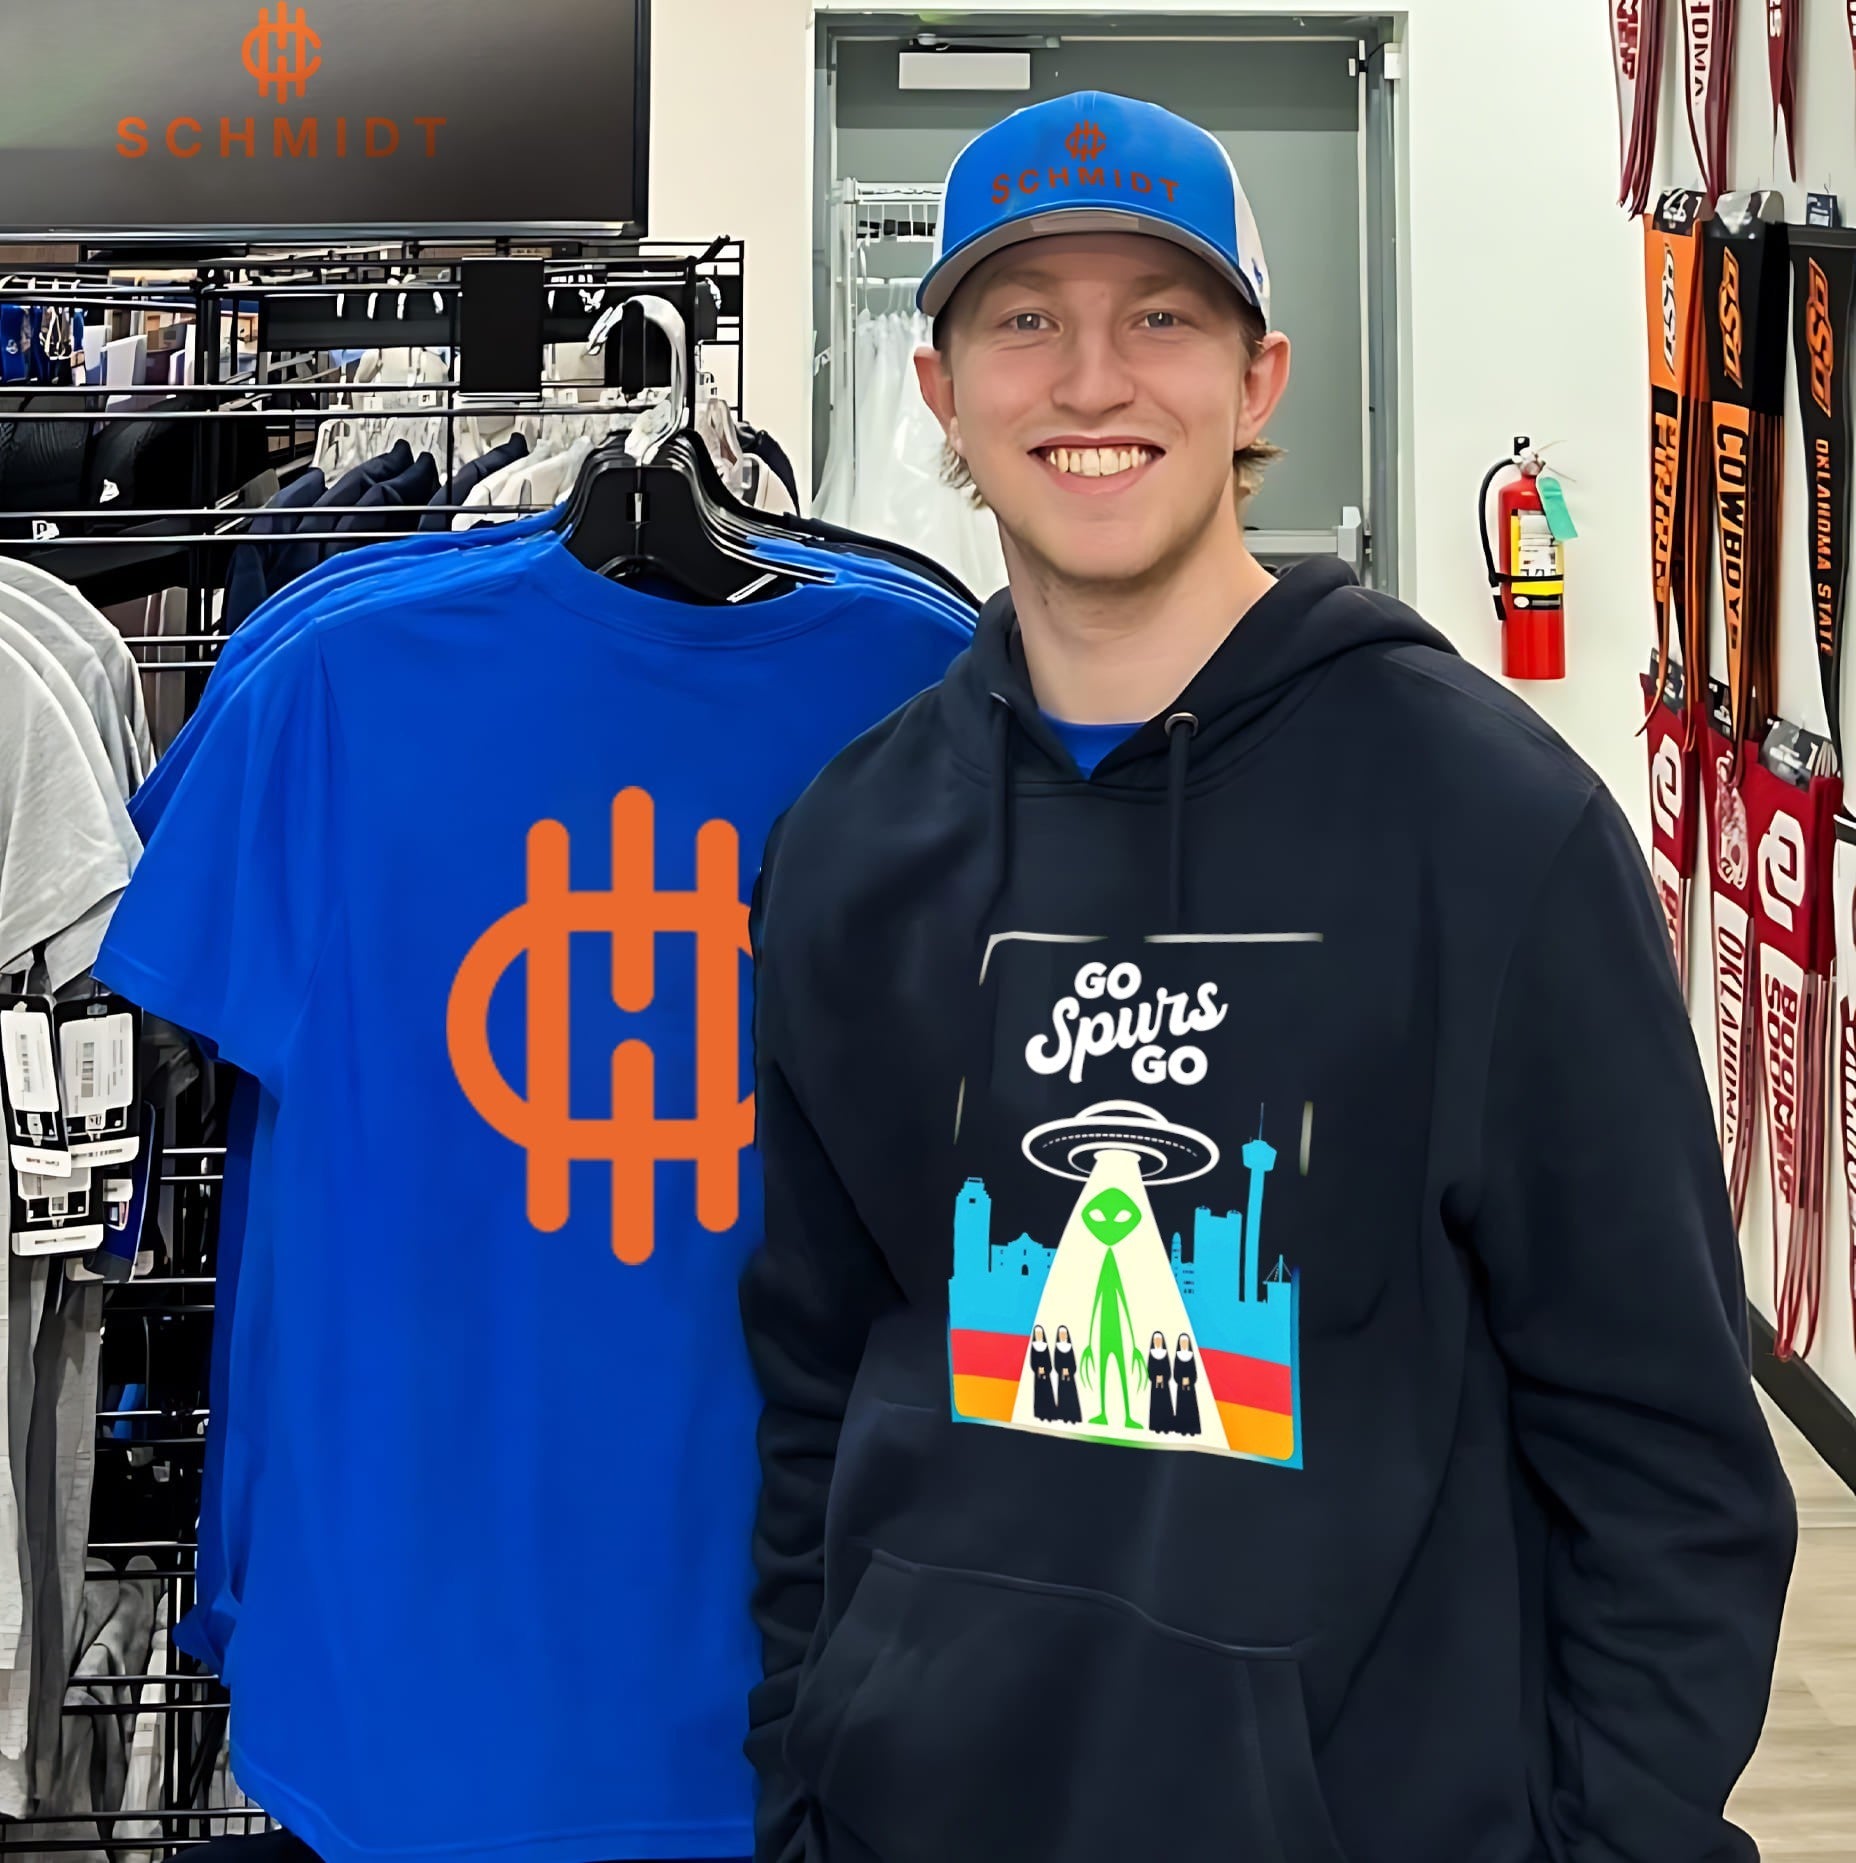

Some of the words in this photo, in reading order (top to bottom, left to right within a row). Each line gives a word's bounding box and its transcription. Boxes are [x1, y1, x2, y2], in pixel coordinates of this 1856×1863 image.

[115, 116, 448, 159] SCHMIDT
[991, 167, 1179, 205] SCHMIDT
[1074, 962, 1142, 999] GO
[1025, 982, 1229, 1084] Spurs
[1131, 1045, 1209, 1086] GO
